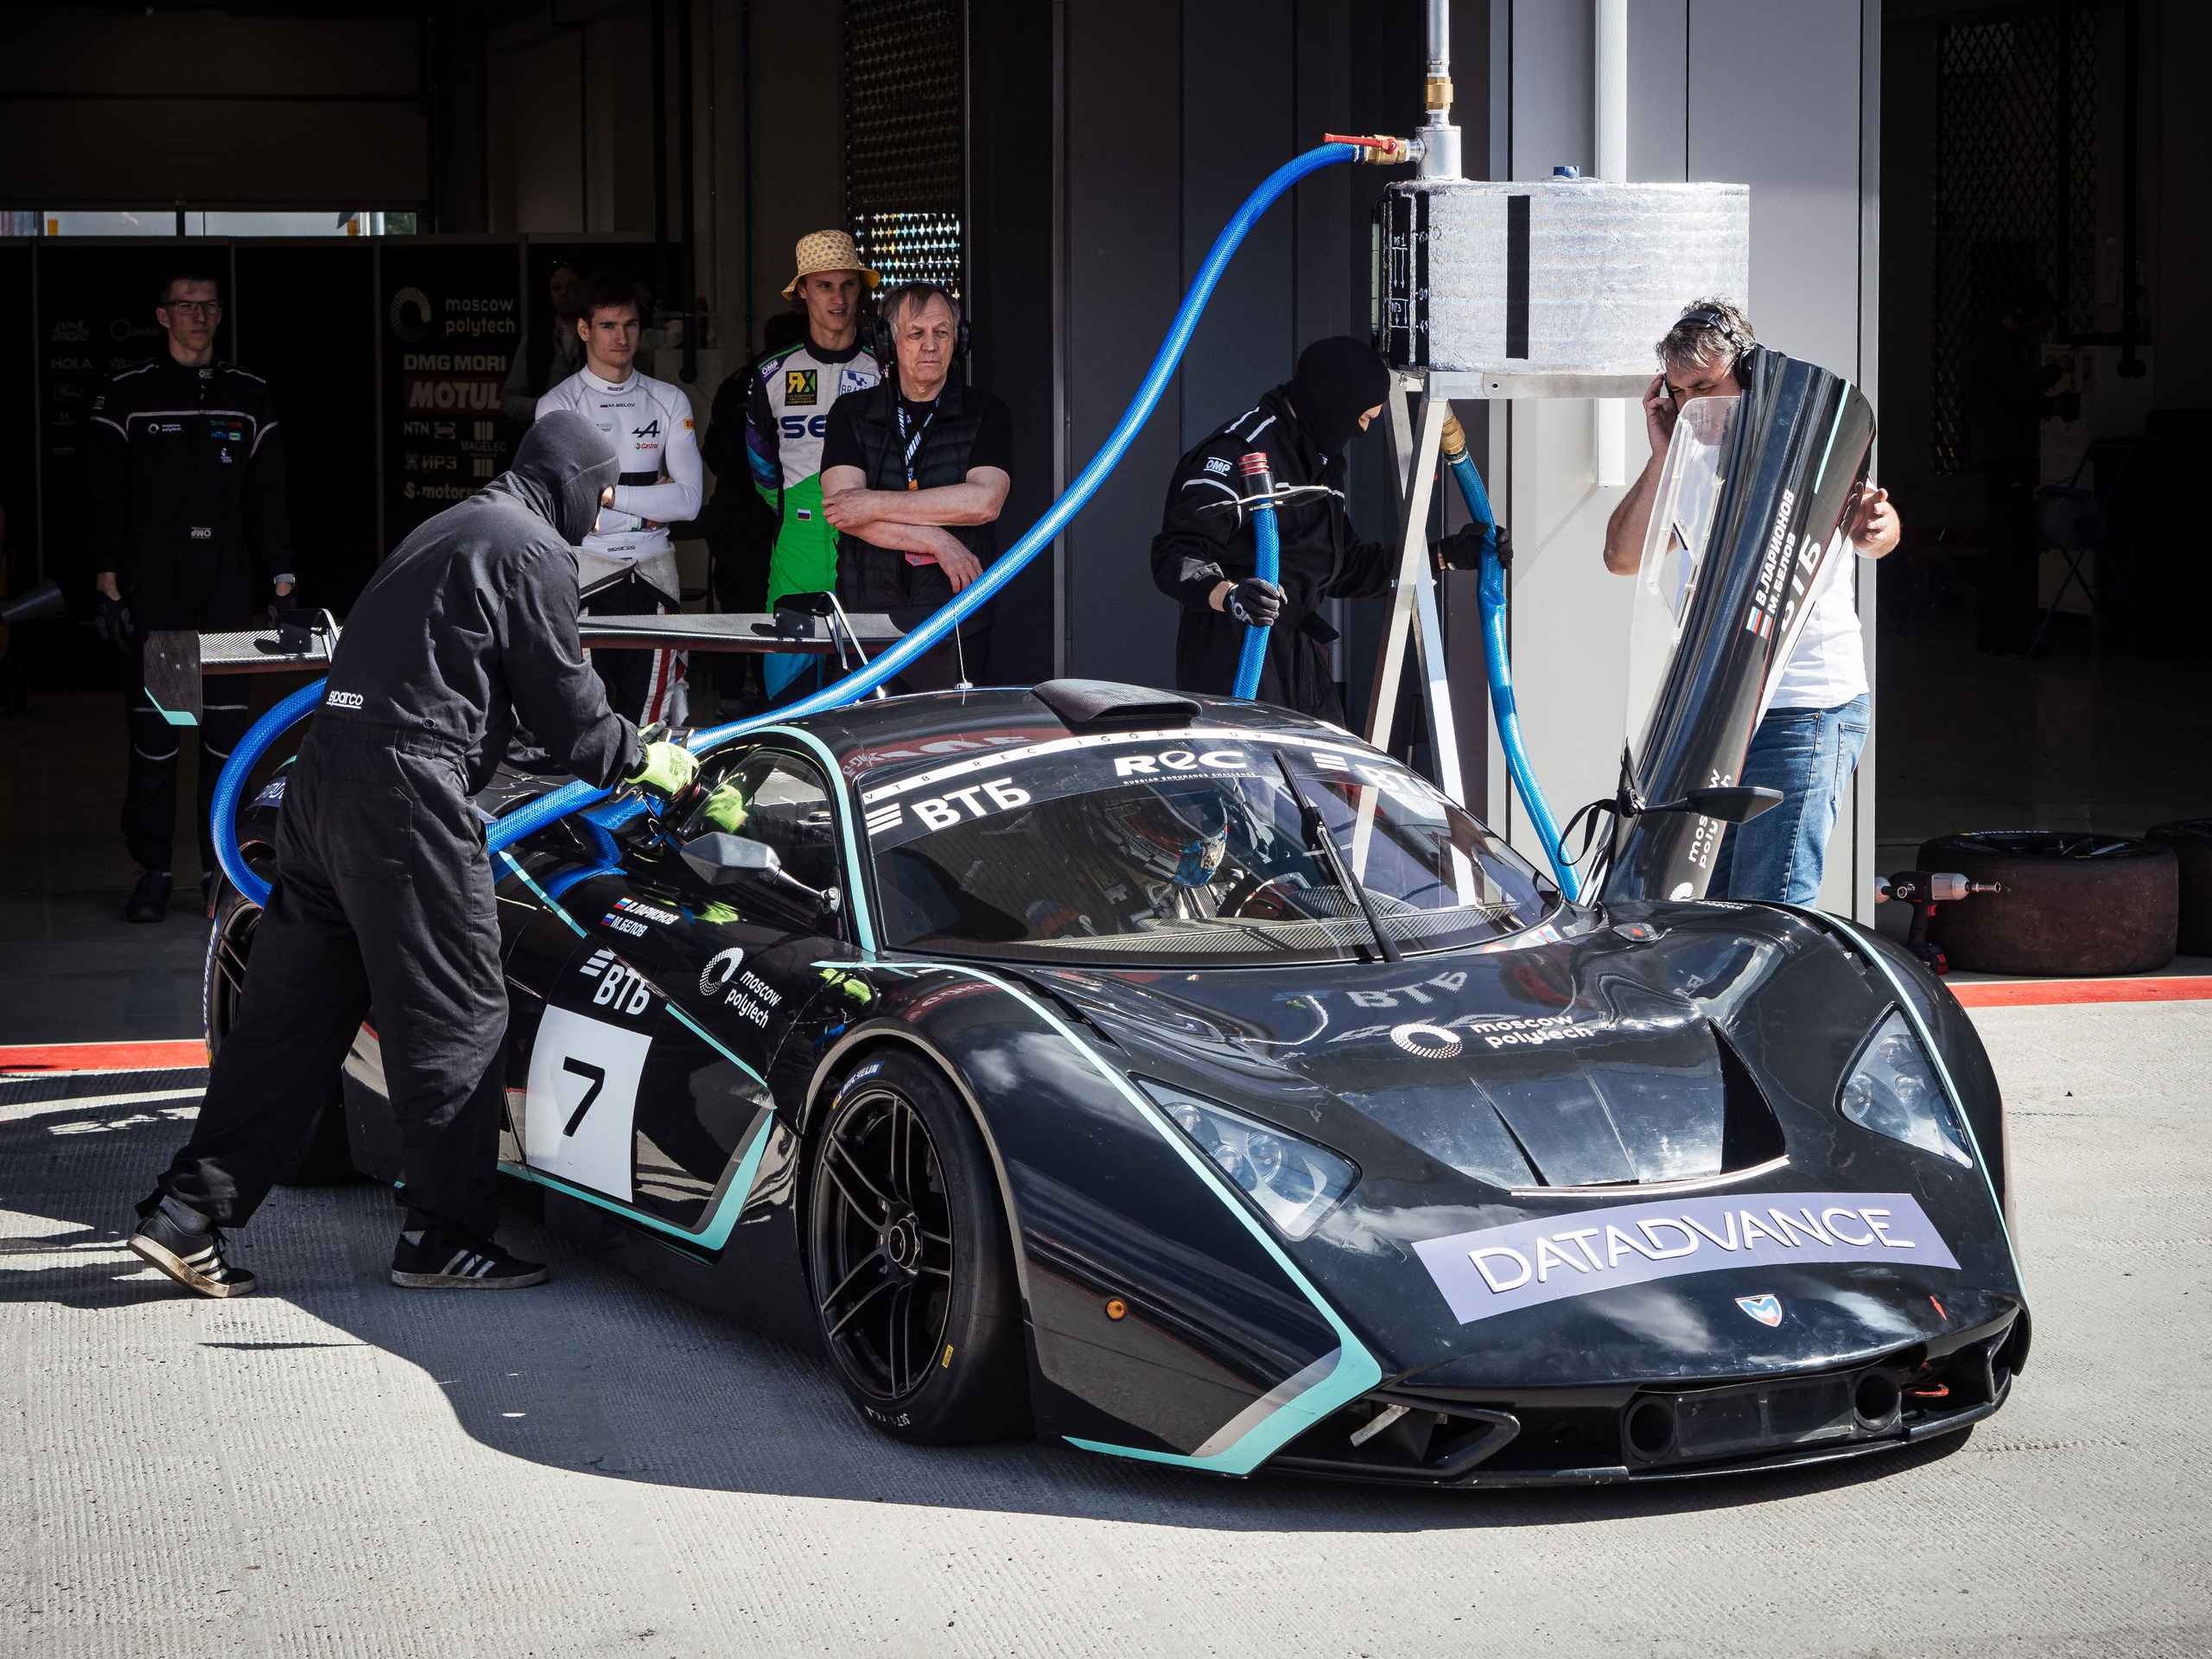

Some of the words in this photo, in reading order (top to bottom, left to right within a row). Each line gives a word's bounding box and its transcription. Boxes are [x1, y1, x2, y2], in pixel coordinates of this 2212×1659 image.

[445, 298, 514, 312] moscow
[445, 317, 517, 337] polytech
[51, 358, 93, 369] HOLA
[404, 354, 451, 372] DMG
[454, 355, 506, 372] MORI
[762, 361, 779, 375] OMP
[410, 382, 501, 410] MOTUL
[404, 422, 429, 435] NTN
[461, 441, 506, 452] MAGELEC
[1206, 460, 1231, 473] OMP
[1755, 488, 1796, 607] В.ЛАРИОНОВ
[327, 690, 364, 707] sparco
[910, 777, 1032, 832] ВТБ
[623, 901, 680, 925] В.ЛАРИОНОВ
[610, 916, 648, 938] М.БЕЛОВ
[593, 963, 651, 1015] ВТБ
[739, 970, 783, 1007] moscow
[724, 988, 769, 1028] polytech
[1468, 1014, 1575, 1034] moscow
[1484, 1023, 1596, 1049] polytech
[842, 1064, 880, 1094] MICHELIN
[563, 1056, 605, 1137] 7
[1468, 1208, 1916, 1294] DATADVANCE
